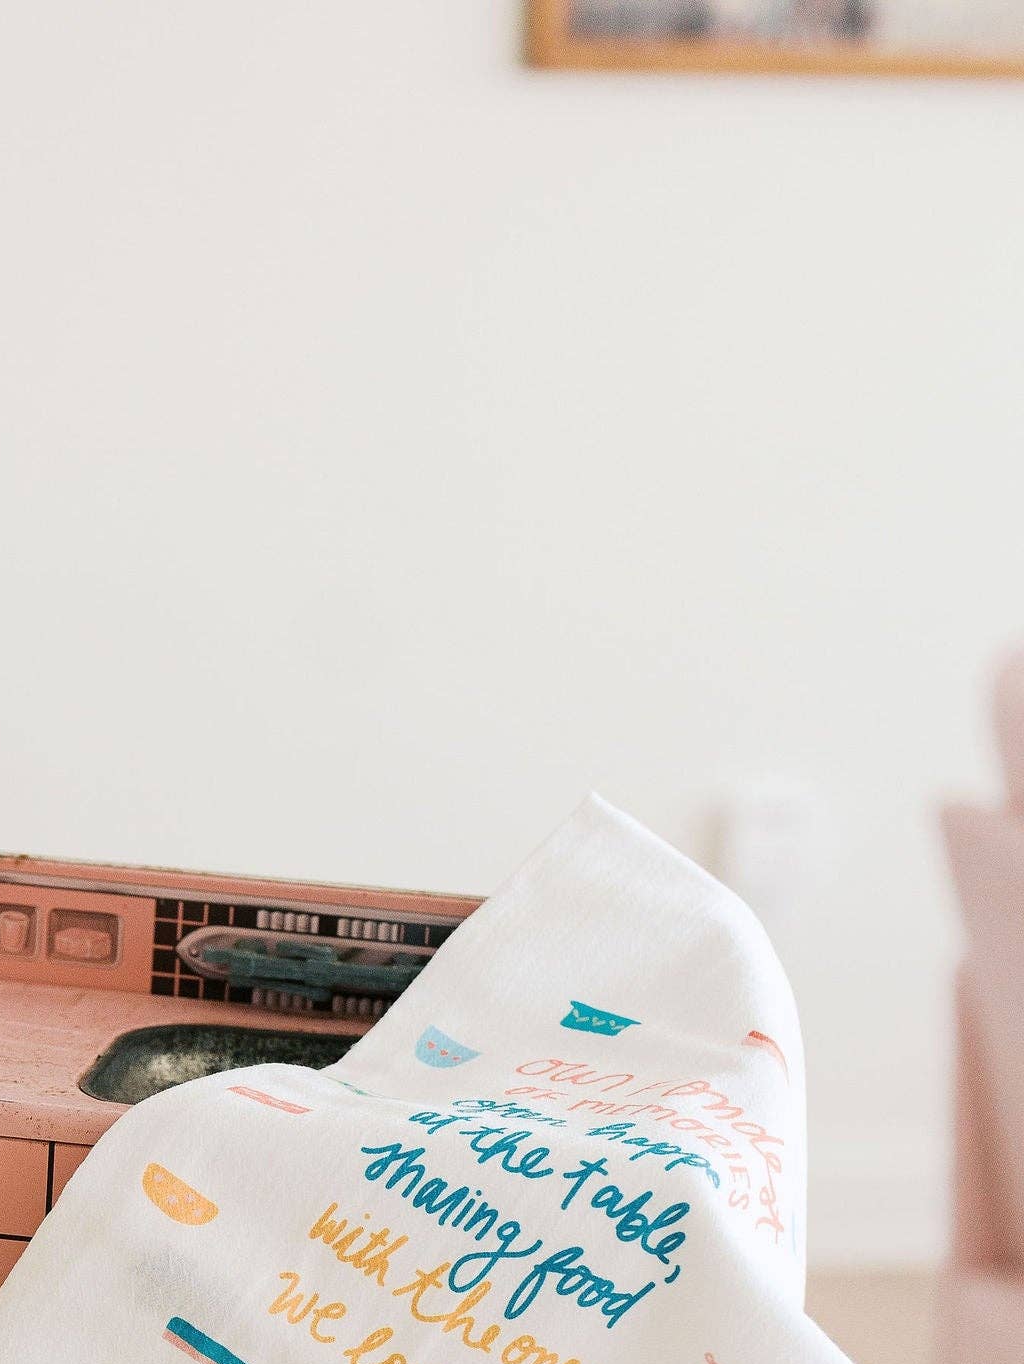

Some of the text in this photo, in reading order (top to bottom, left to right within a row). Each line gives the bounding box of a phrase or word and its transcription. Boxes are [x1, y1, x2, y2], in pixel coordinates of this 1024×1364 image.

[308, 1201, 410, 1288] with
[391, 1261, 502, 1354] the
[360, 1142, 656, 1330] sharing food
[408, 1110, 690, 1284] at the table,
